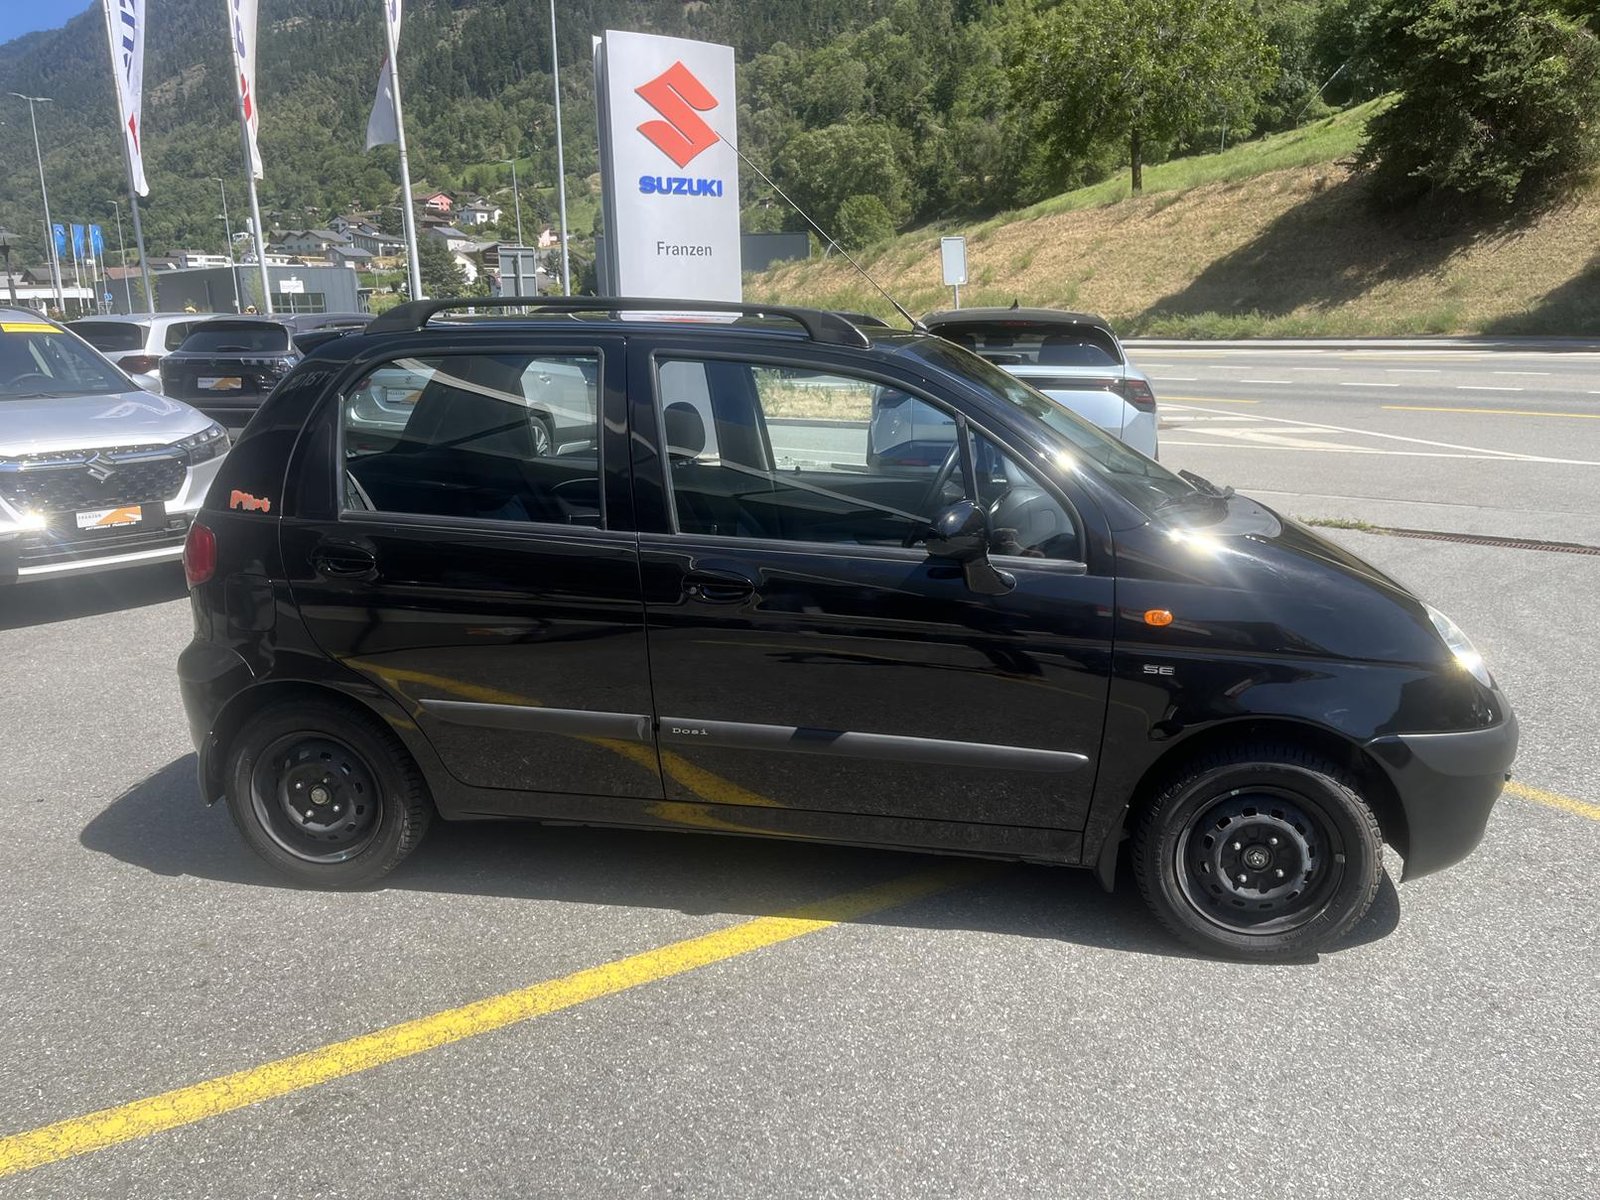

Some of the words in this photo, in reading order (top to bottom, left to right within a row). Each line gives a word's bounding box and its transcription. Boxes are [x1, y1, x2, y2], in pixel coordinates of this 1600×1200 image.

[639, 176, 722, 197] SUZUKI
[656, 241, 713, 257] Franzen
[1143, 664, 1175, 676] SE
